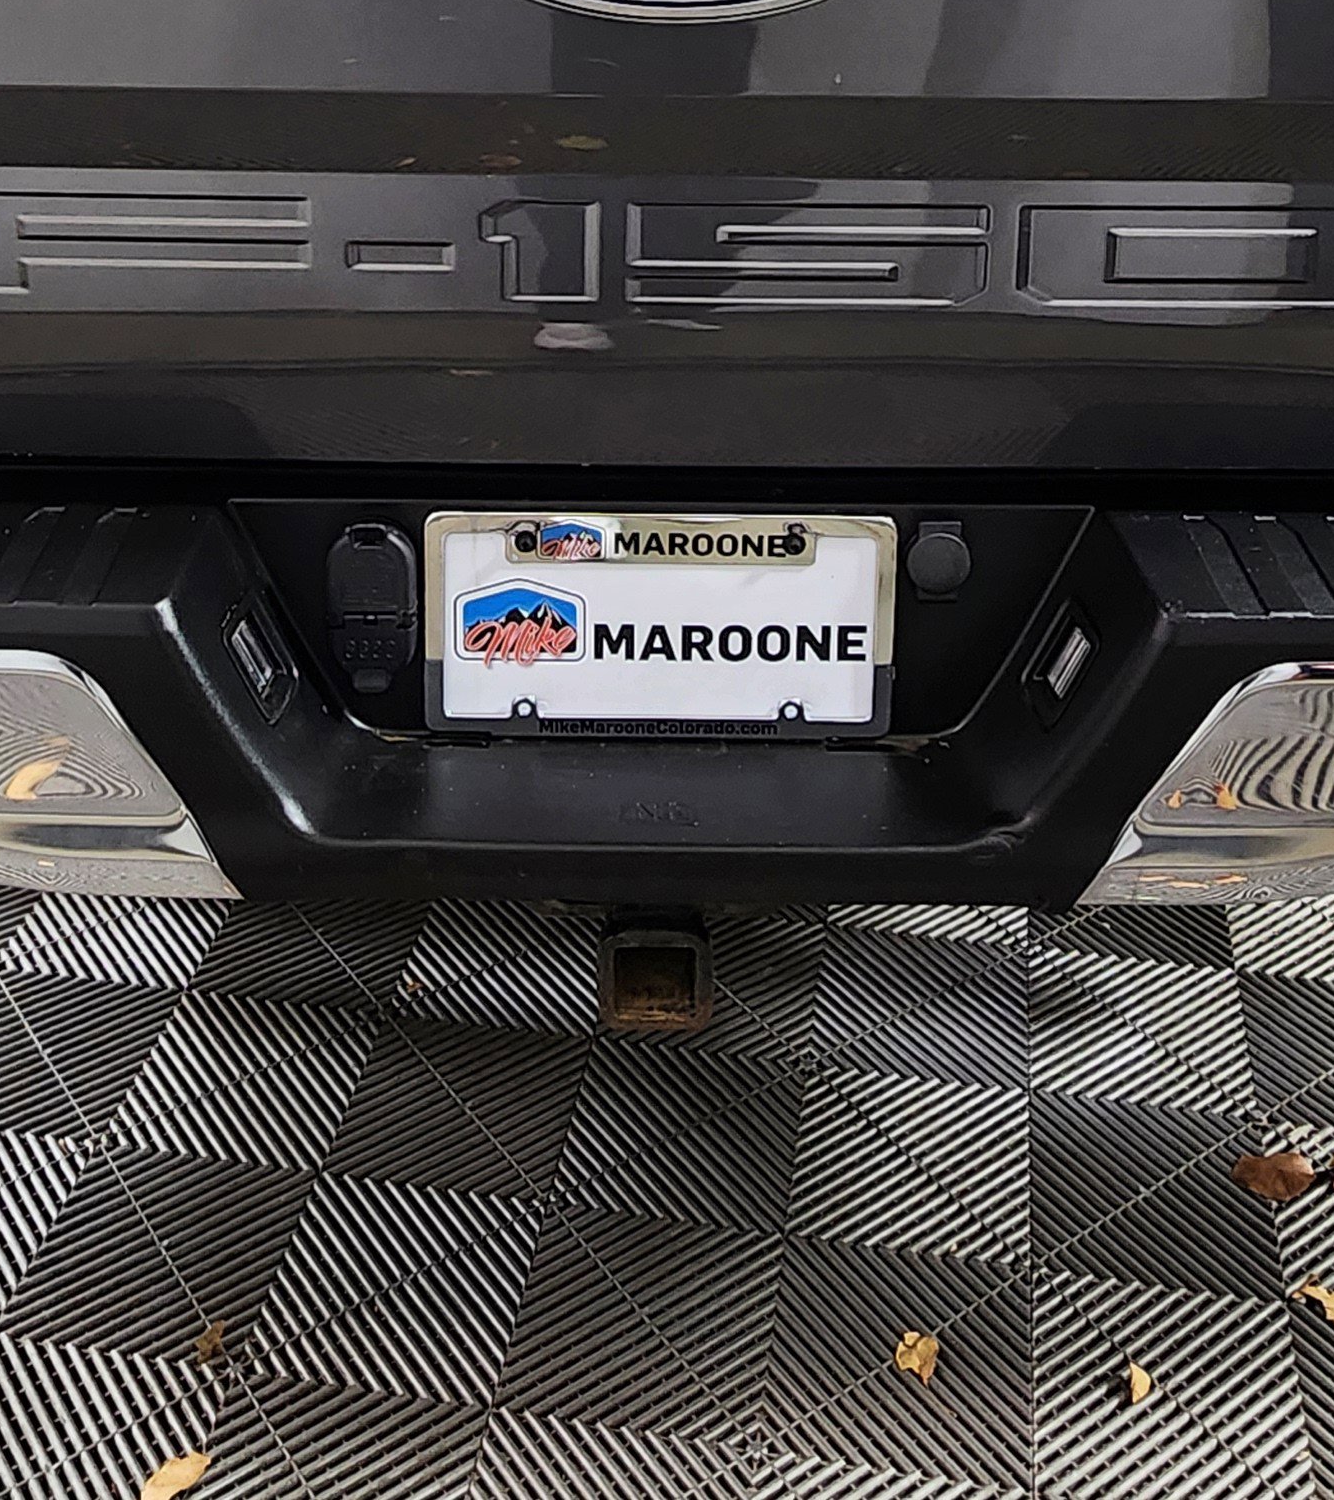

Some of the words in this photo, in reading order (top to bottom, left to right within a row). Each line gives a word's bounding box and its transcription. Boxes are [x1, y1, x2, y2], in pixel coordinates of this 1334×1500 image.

[541, 532, 602, 560] Mike
[614, 531, 787, 557] MAROONE
[464, 619, 578, 669] Mike
[592, 623, 868, 662] MAROONE
[538, 719, 780, 737] MikeMarooneColorado.com
